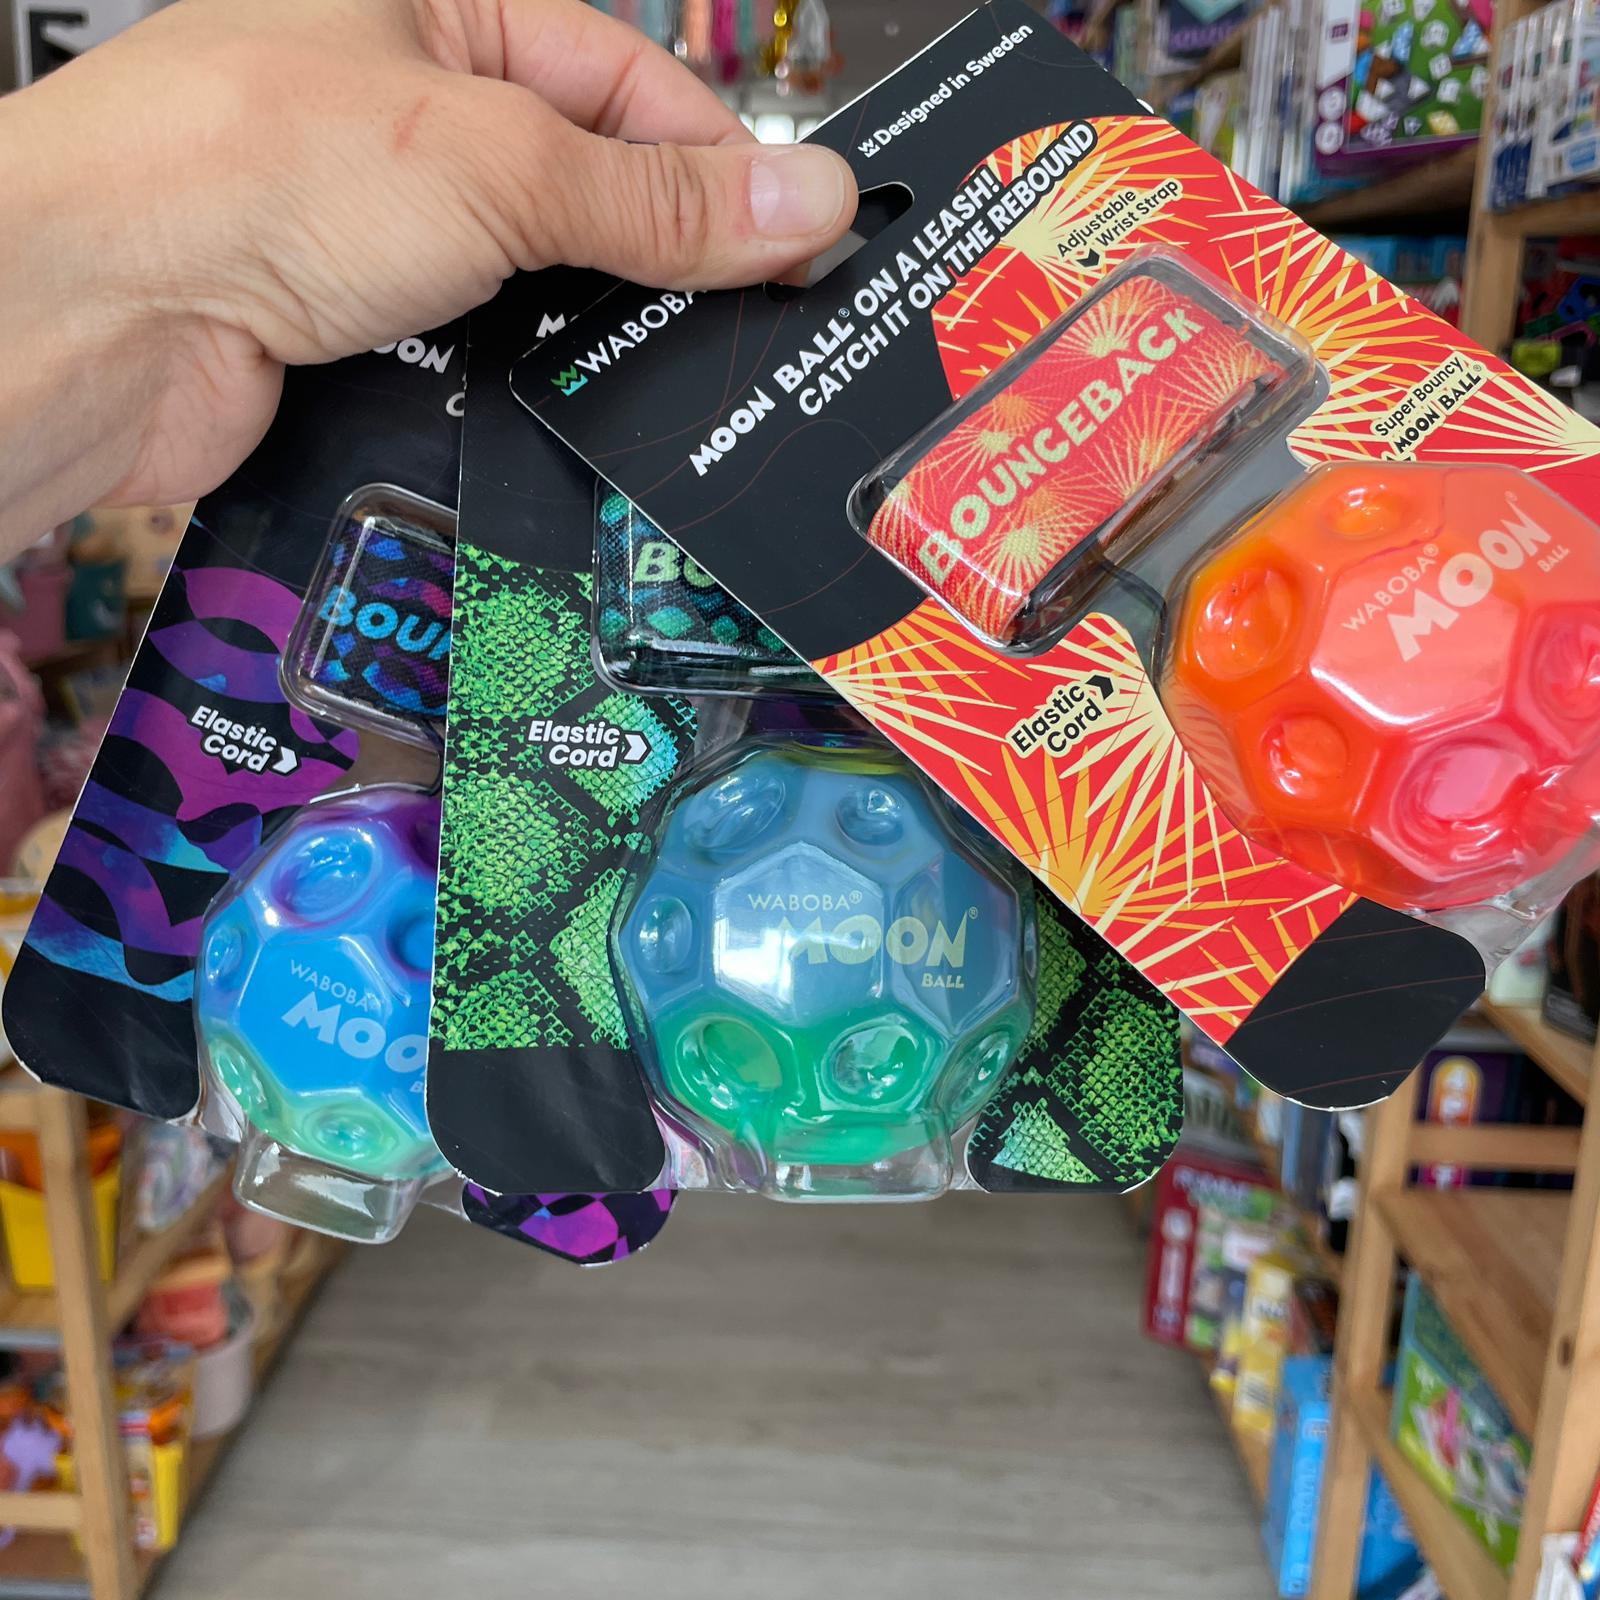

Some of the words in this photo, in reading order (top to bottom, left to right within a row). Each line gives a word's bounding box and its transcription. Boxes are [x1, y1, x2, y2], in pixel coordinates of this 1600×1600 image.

[873, 83, 952, 146] Designed
[947, 73, 971, 90] in
[966, 24, 1033, 76] Sweden
[1057, 191, 1136, 257] Adjustable
[1096, 211, 1139, 247] Wrist
[1136, 181, 1178, 215] Strap
[799, 316, 889, 416] CATCH
[882, 302, 909, 337] IT
[908, 265, 950, 310] ON
[943, 220, 994, 273] THE
[988, 124, 1094, 232] REBOUND
[689, 386, 776, 476] MOON
[854, 269, 896, 317] ON
[895, 252, 921, 281] A
[913, 169, 1001, 260] LEASH!
[1375, 398, 1416, 436] Super
[1413, 357, 1463, 402] Bouncy
[918, 308, 1204, 586] BOUNCEBACK
[1394, 405, 1440, 453] MOON
[1537, 545, 1570, 572] BALL
[191, 705, 277, 752] Elastic
[528, 720, 620, 745] Elastic
[1011, 686, 1085, 752] Elastic
[1047, 698, 1102, 752] Cord
[204, 734, 271, 772] Cord
[549, 744, 618, 768] Cord
[921, 973, 964, 988] BALL
